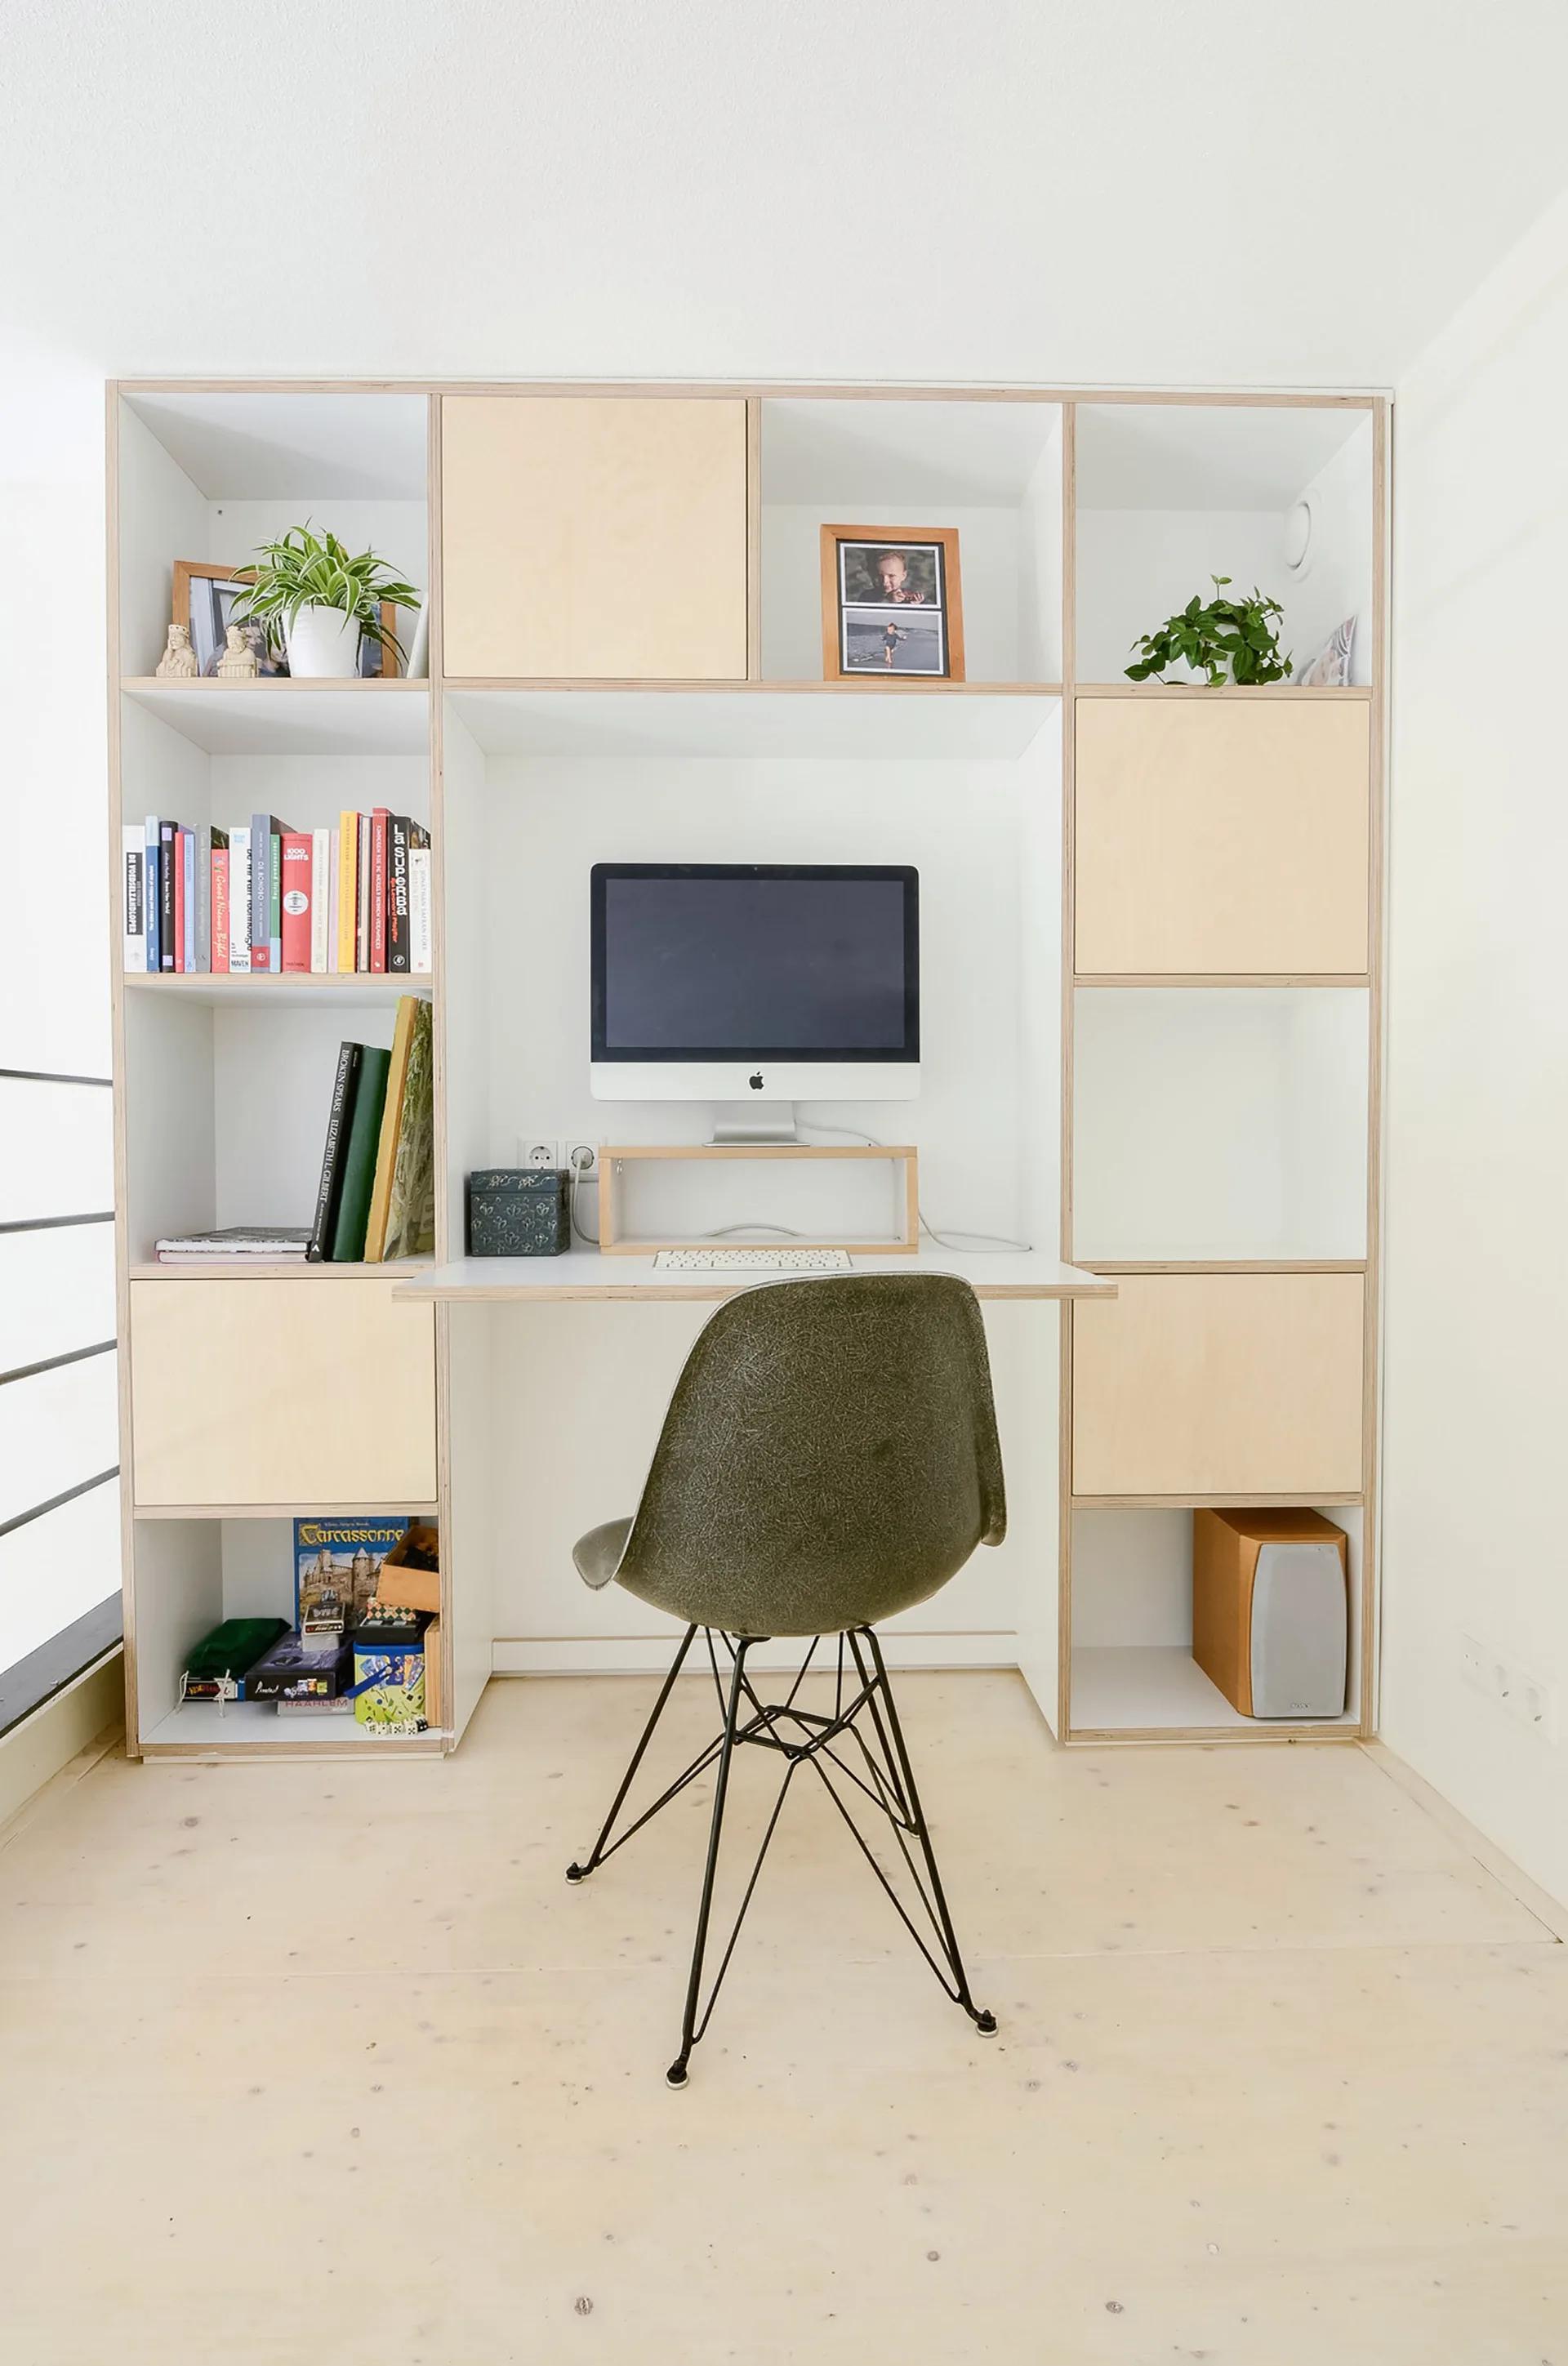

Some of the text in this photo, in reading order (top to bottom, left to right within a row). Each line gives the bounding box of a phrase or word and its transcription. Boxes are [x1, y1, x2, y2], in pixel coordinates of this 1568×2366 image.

[394, 824, 406, 845] La
[257, 861, 265, 870] DE
[128, 854, 136, 933] DE VOEDSELZANDLOPER
[214, 875, 227, 958] Groot Nieuws Bijbel
[333, 1049, 350, 1112] BROKEN SPEARS
[325, 1119, 339, 1161] ELIZABETH
[320, 1170, 332, 1203] GILBERT
[301, 1524, 404, 1544] Carcassonne
